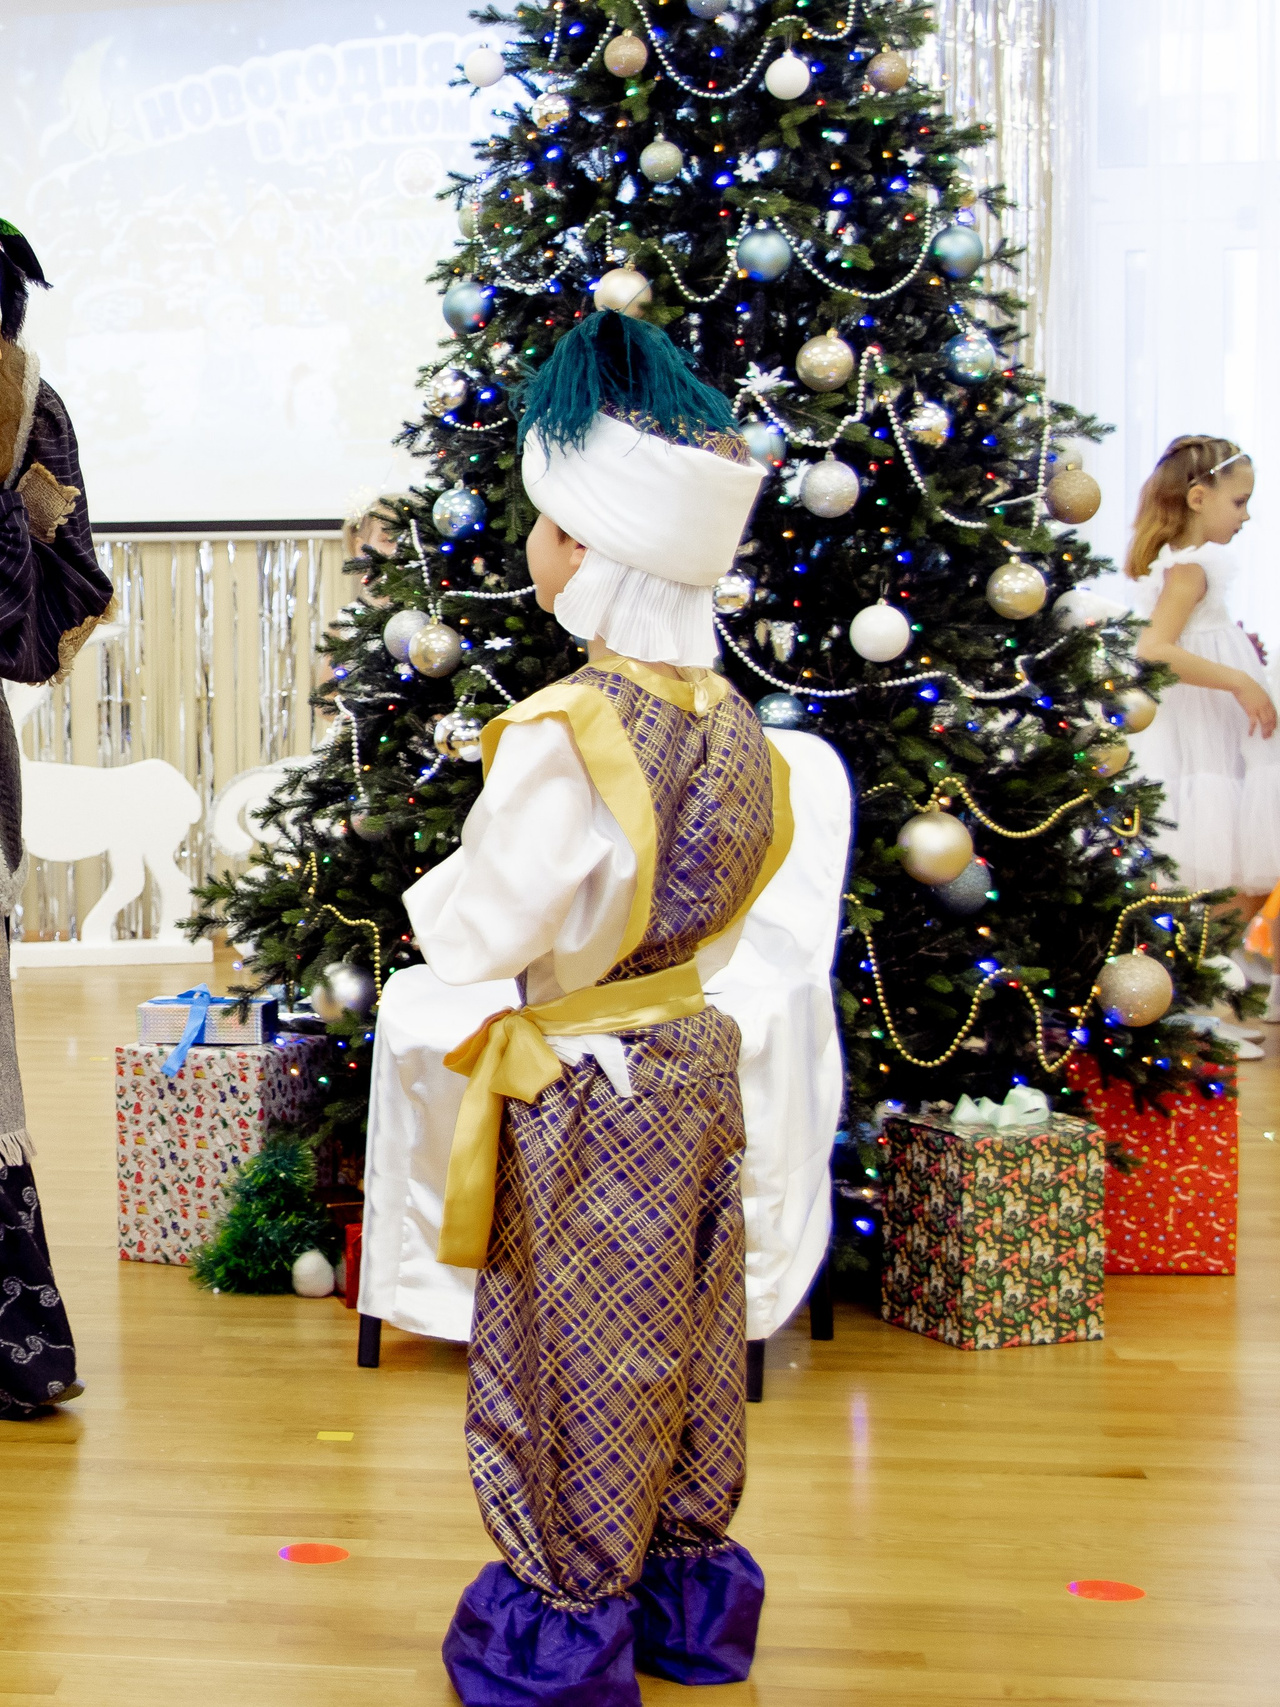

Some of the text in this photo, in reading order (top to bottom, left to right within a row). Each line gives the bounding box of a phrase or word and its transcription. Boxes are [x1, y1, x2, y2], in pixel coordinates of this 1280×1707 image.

[140, 40, 491, 140] НОВОГОДНЯ
[255, 120, 284, 156] В
[290, 97, 471, 158] ДЕТСКОМ
